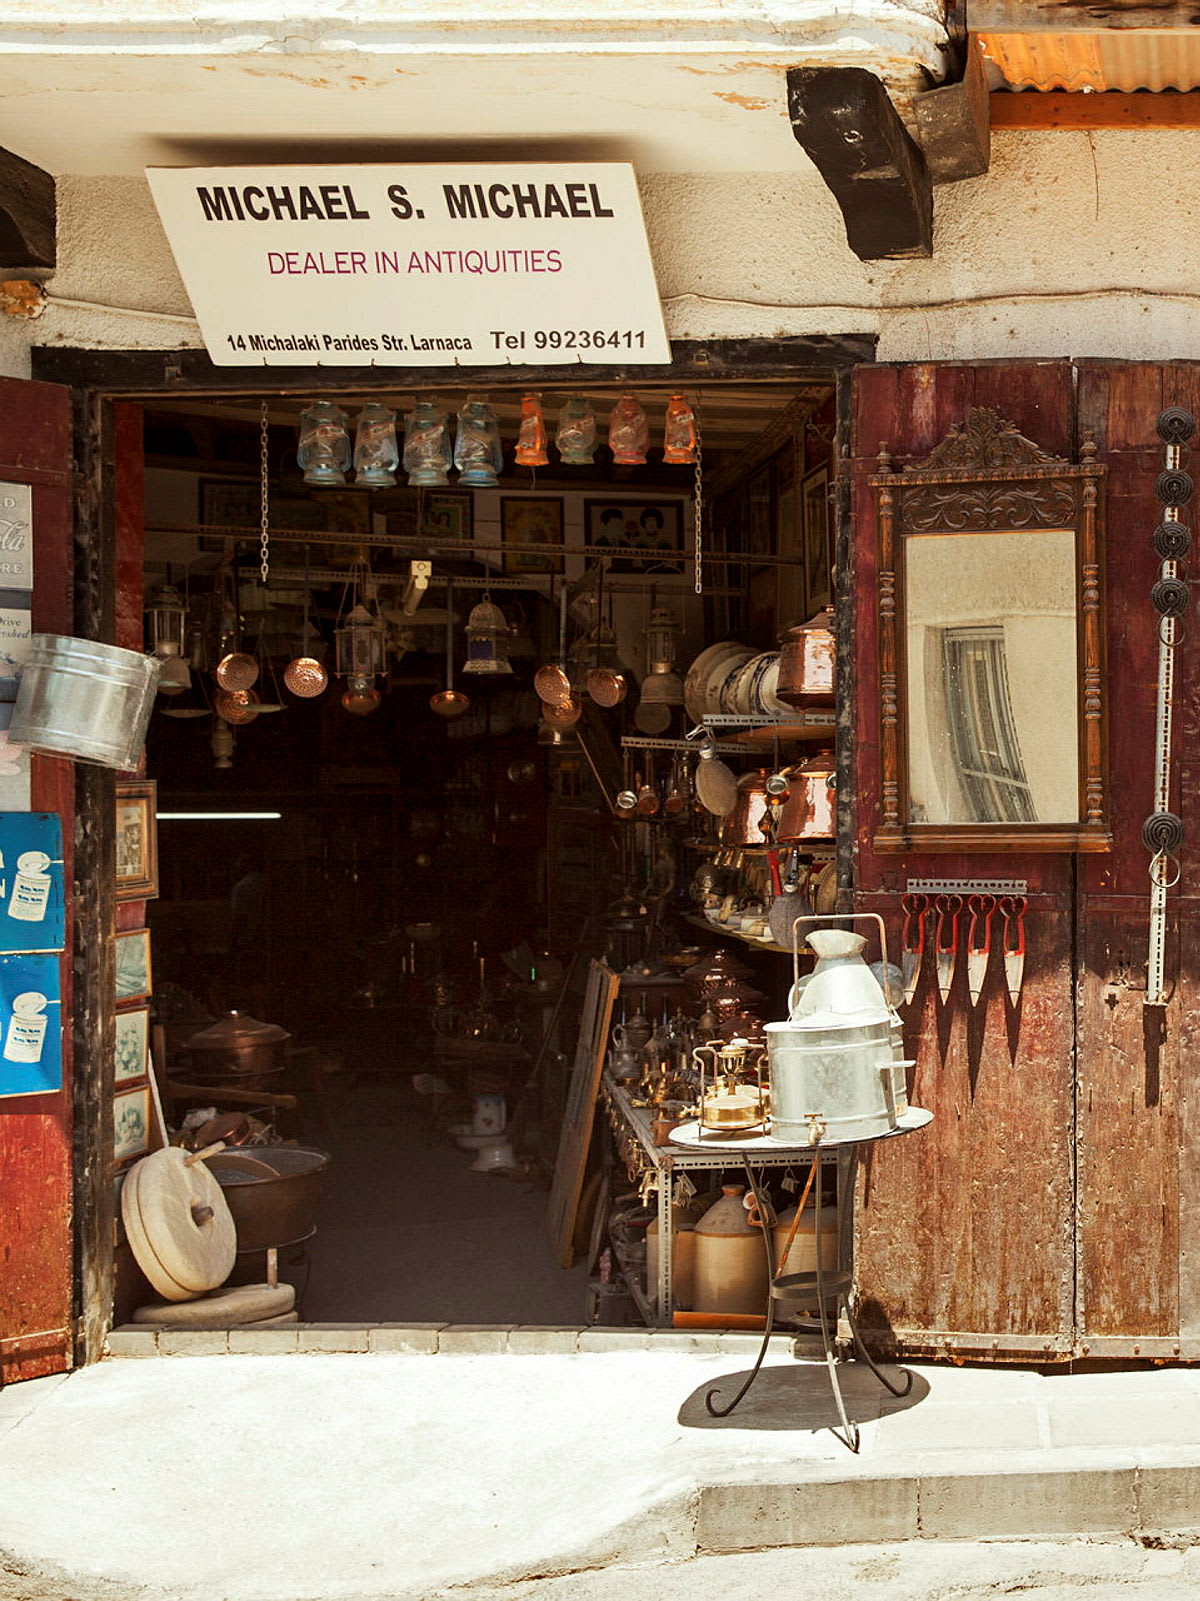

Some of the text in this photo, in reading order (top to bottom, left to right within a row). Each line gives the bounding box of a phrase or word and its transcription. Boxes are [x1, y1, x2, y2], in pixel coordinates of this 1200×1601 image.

[196, 183, 614, 221] MICHAEL S. MICHAEL
[267, 249, 563, 275] DEALER IN ANTIQUITIES
[227, 330, 645, 351] 14 Michalaki Parides Str. Larnaca Tel 99236411
